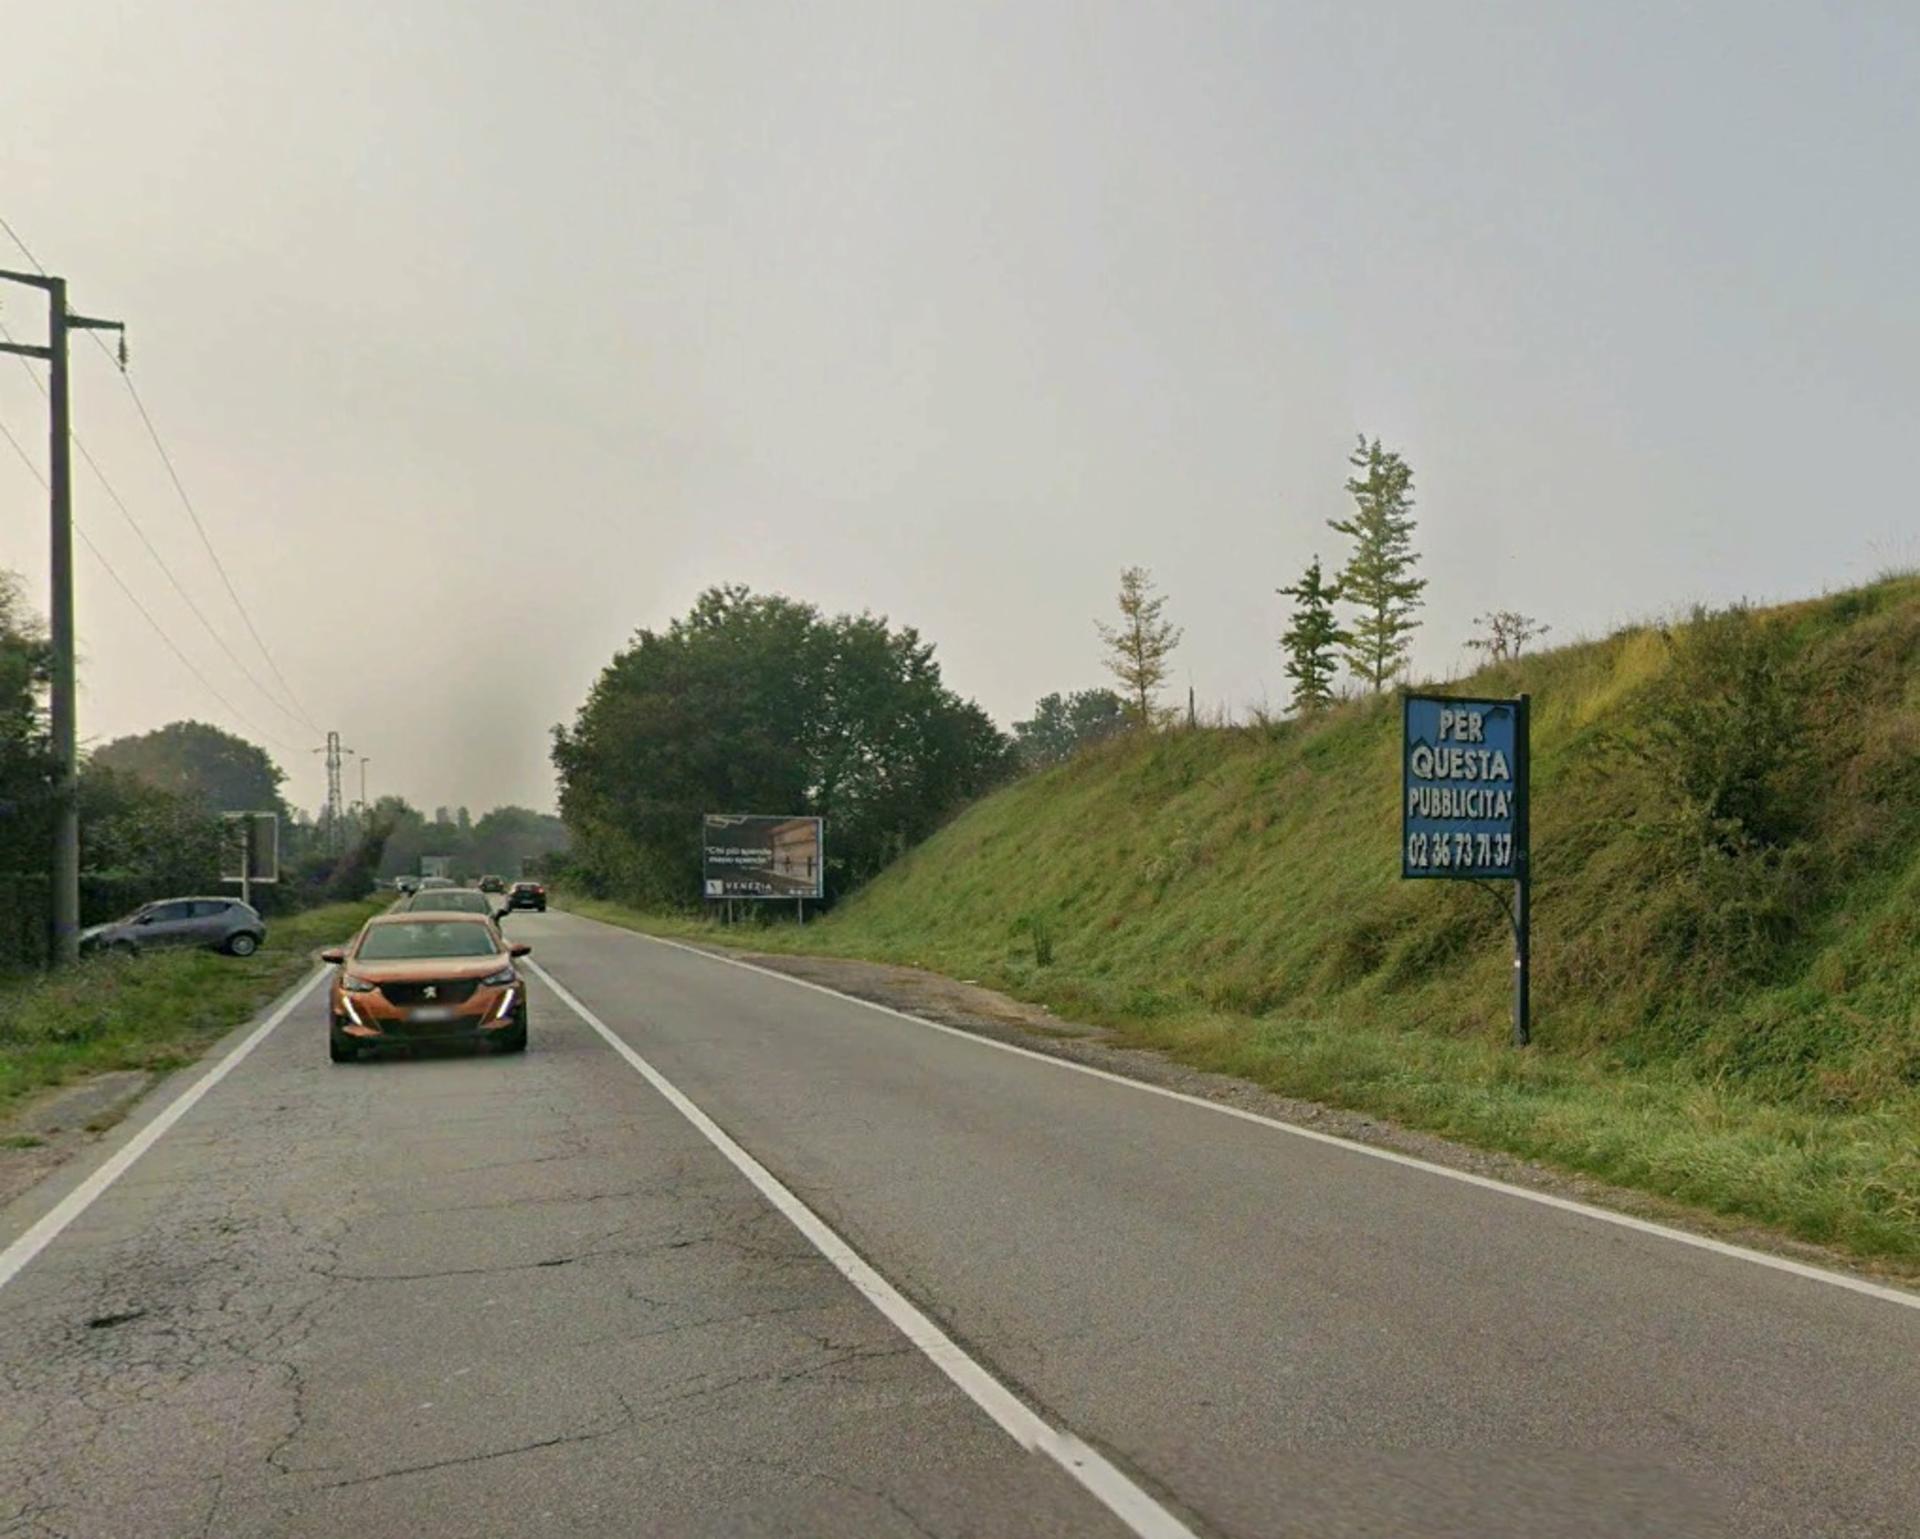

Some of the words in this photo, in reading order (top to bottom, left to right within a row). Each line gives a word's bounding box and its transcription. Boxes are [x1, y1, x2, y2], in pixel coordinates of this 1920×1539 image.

[1440, 709, 1483, 742] PER
[1411, 745, 1510, 780] QUESTA
[1408, 832, 1428, 867] 02
[1432, 832, 1451, 867] 36
[1455, 832, 1473, 867] 73
[1476, 832, 1491, 867] 71
[1494, 832, 1512, 867] 37
